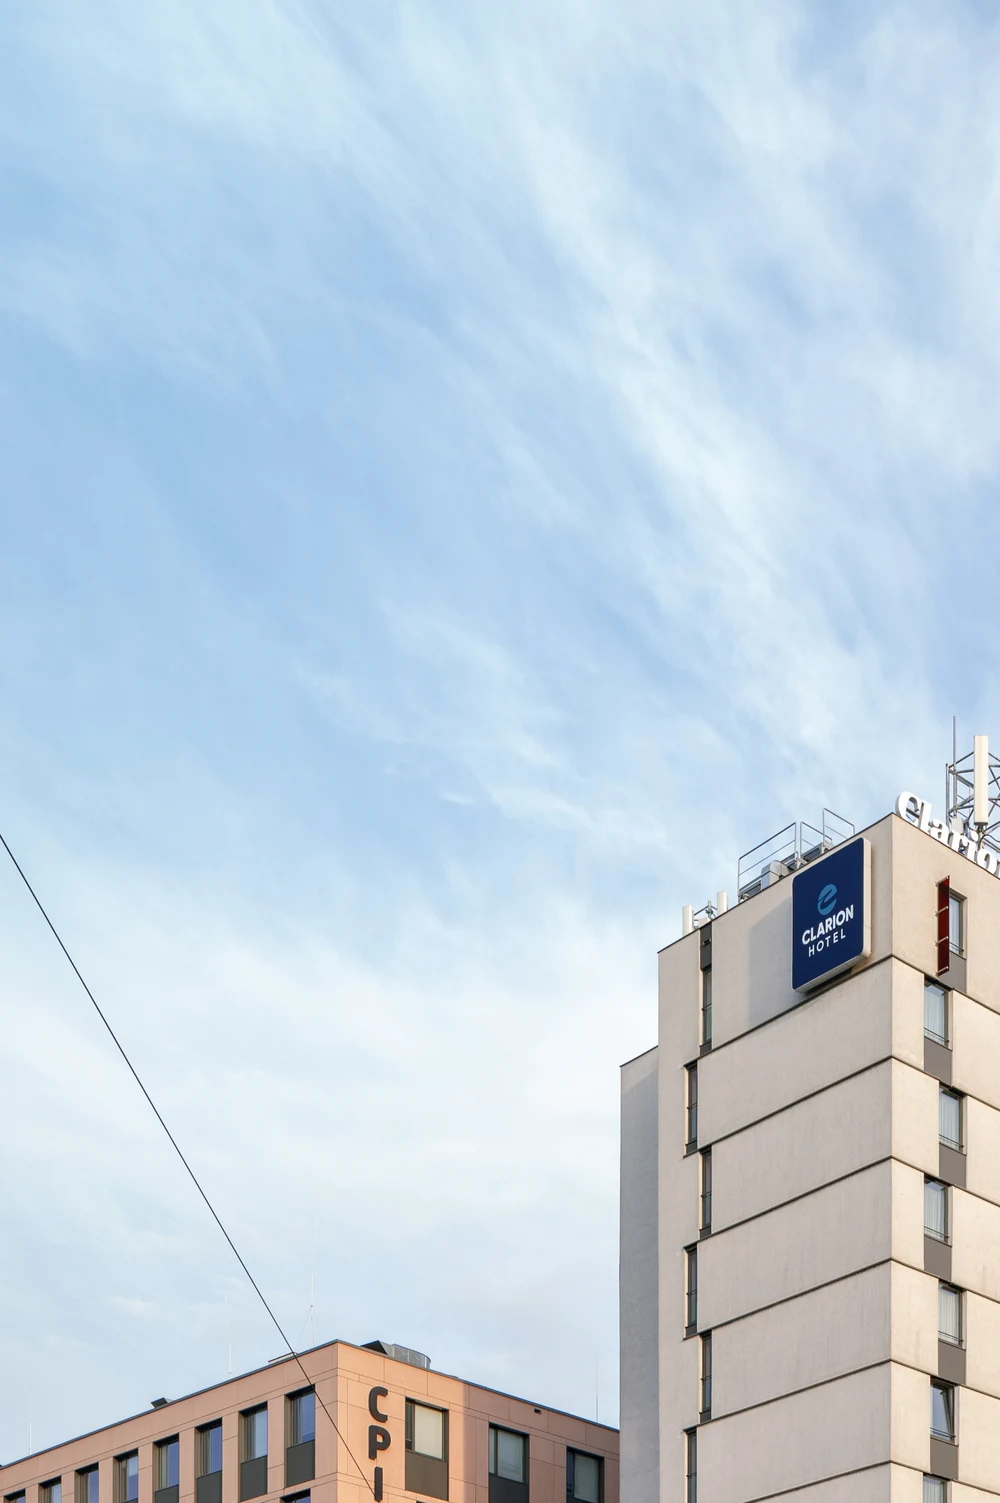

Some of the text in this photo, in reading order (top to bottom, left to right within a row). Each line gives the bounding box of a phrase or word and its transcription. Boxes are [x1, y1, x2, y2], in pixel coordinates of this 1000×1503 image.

[801, 904, 854, 945] CLARION
[808, 928, 846, 957] HOTEL
[367, 1385, 391, 1503] CPI
